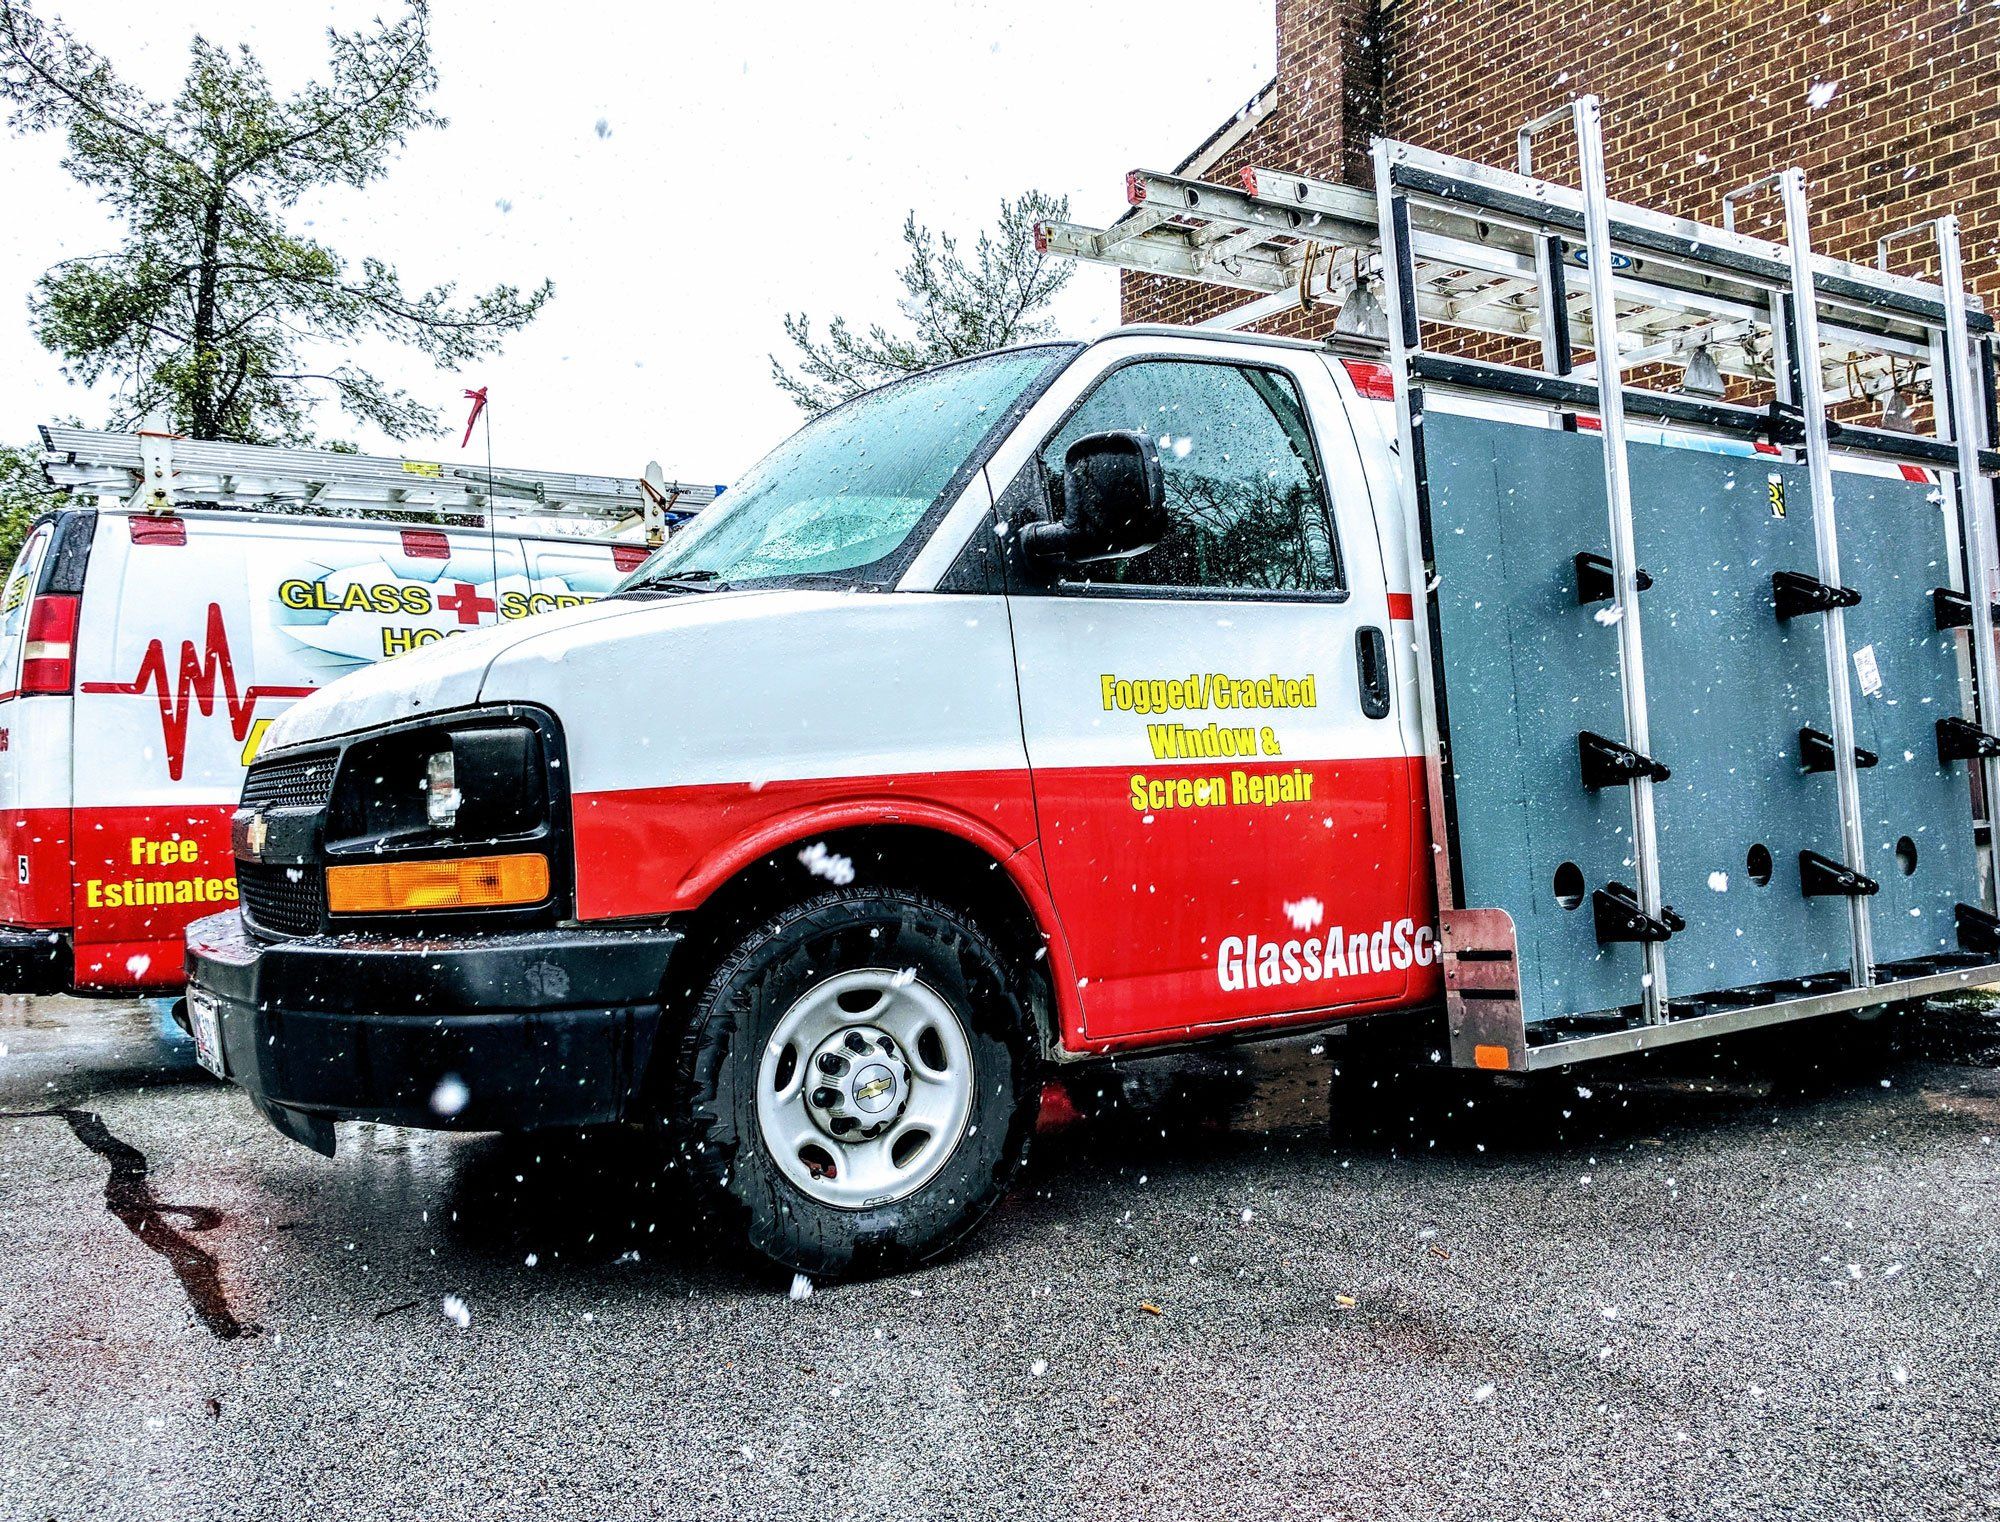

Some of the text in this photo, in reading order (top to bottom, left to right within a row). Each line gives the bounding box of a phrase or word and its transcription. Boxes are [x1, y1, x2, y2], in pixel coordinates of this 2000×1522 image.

[278, 579, 432, 615] GLASS
[381, 626, 466, 657] HO
[1100, 674, 1317, 714] Fogged/Cracked
[1147, 723, 1282, 759] Window &
[1130, 768, 1314, 811] Screen Repair
[131, 836, 199, 865] Free
[20, 857, 27, 881] 5
[87, 876, 240, 908] Estimates
[1217, 917, 1444, 992] GlassAndSc
